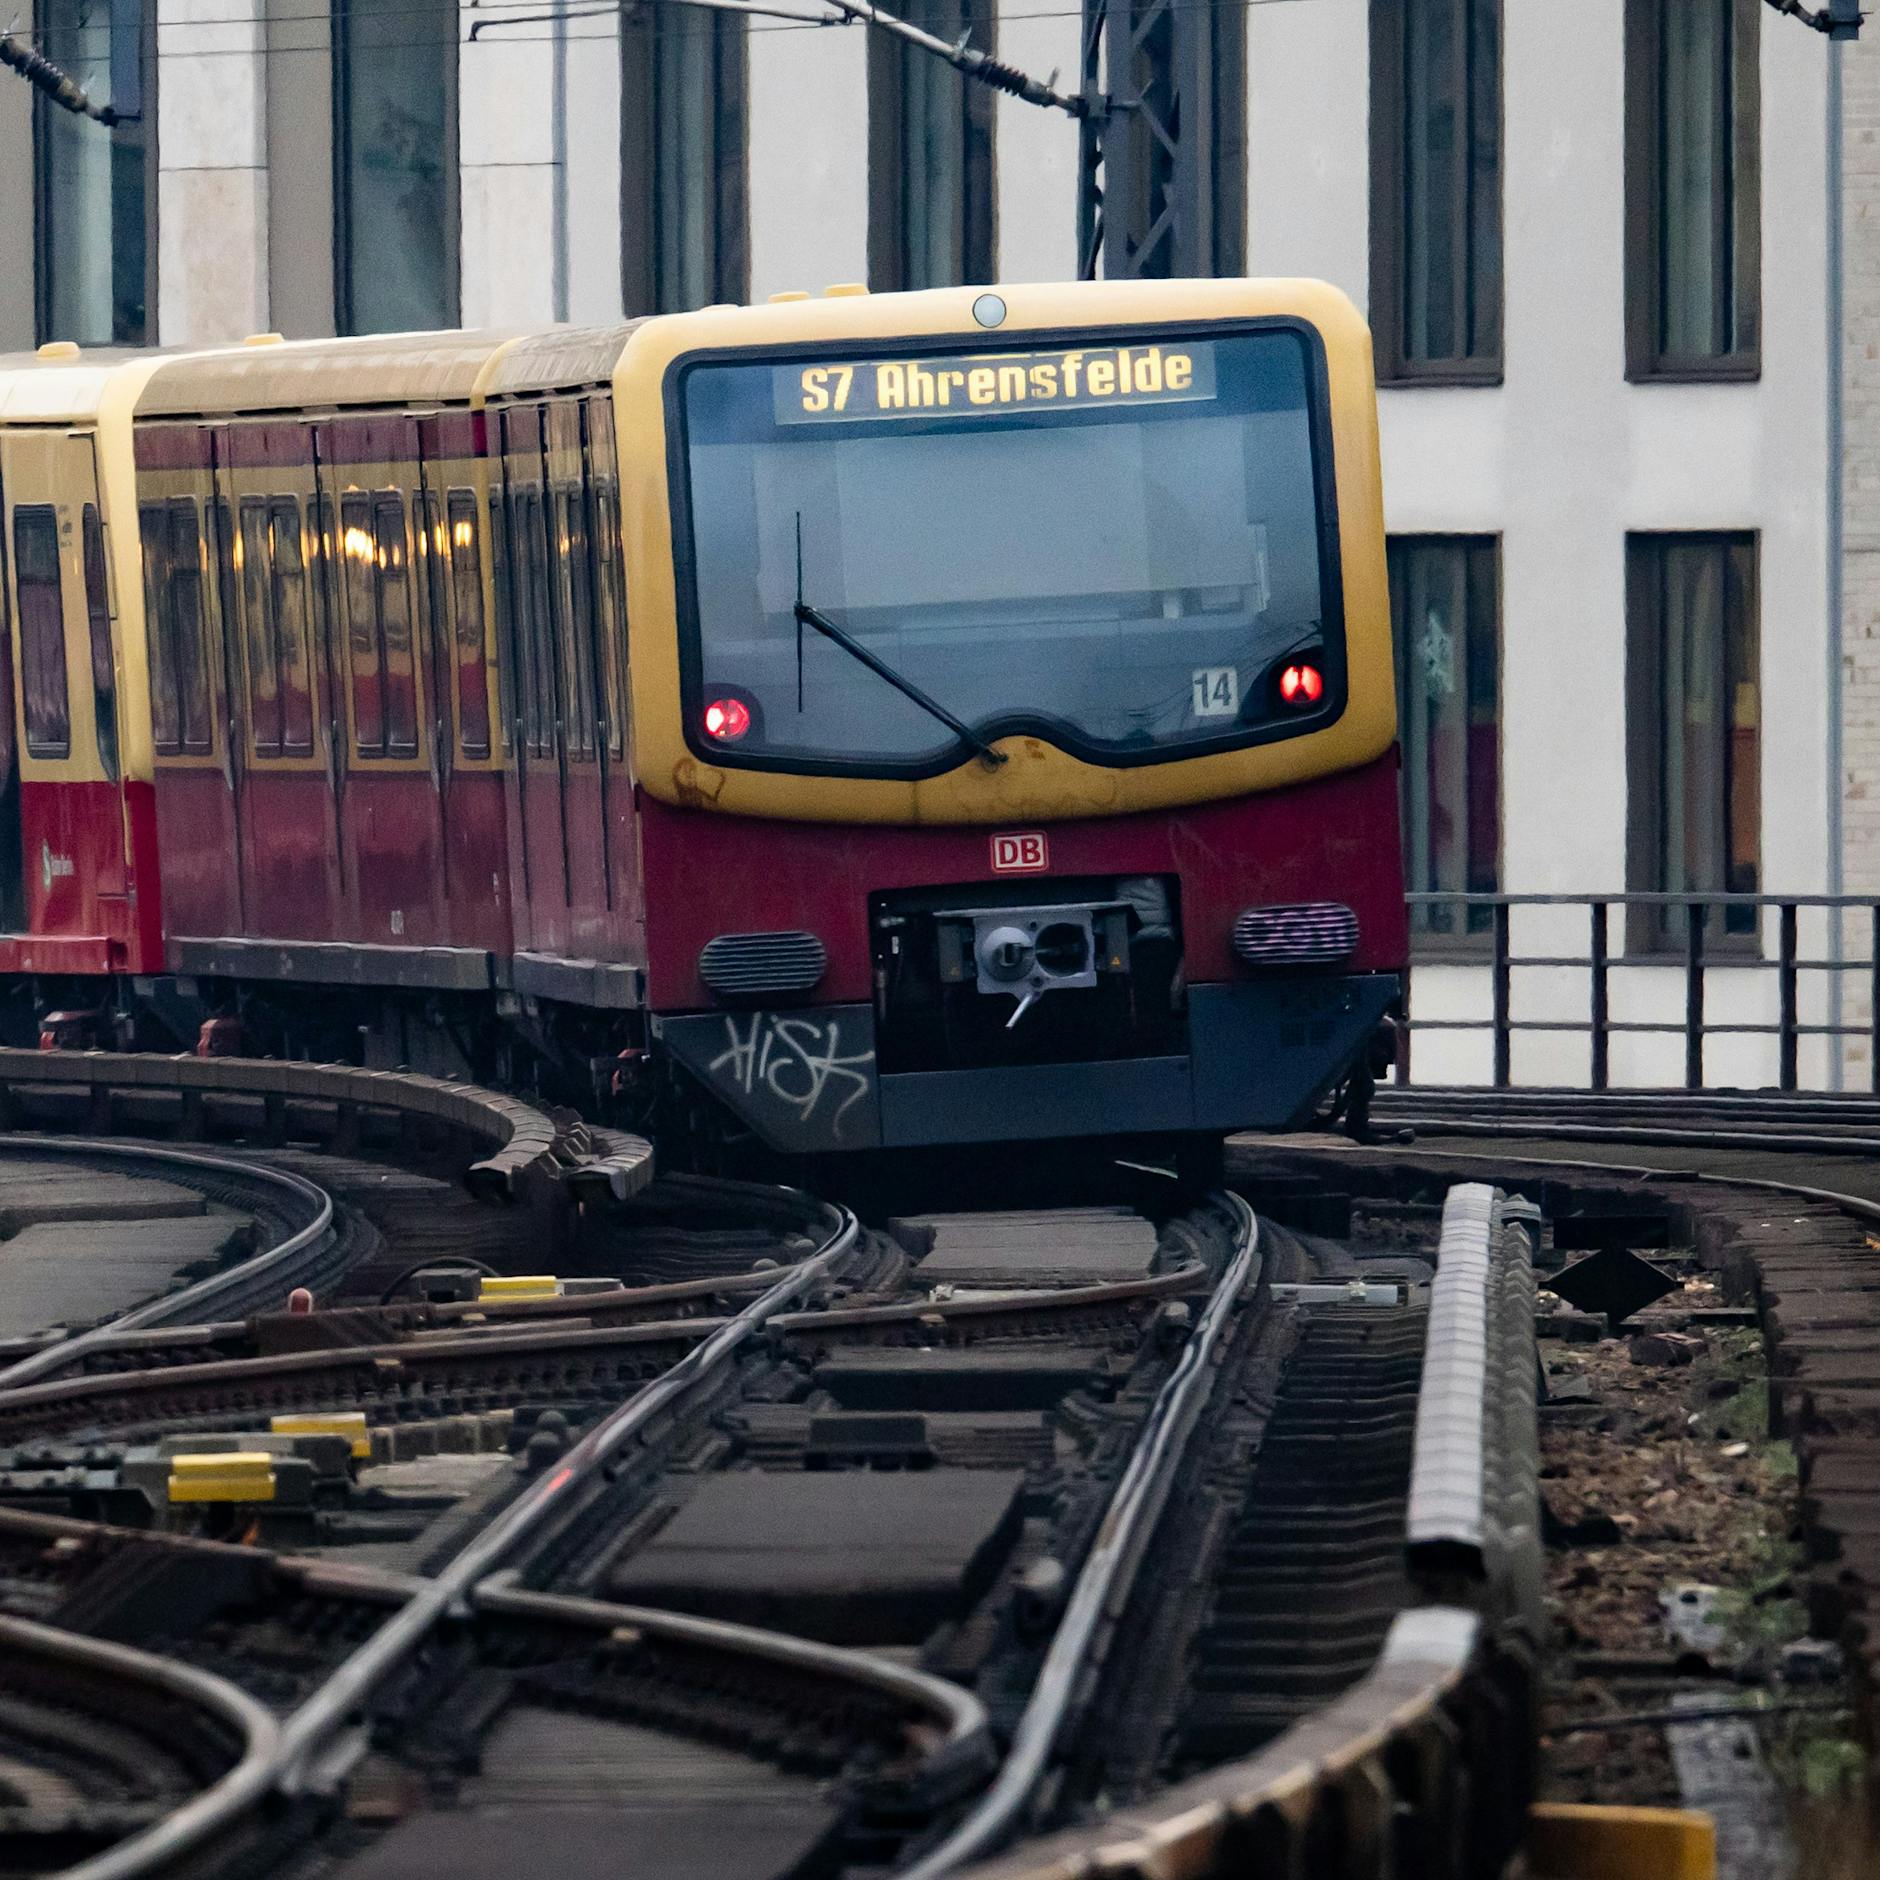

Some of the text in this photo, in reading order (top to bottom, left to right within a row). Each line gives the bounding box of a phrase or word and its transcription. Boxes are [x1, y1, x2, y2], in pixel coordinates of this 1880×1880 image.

[801, 347, 1193, 412] S7 Ahrensfelde
[1194, 671, 1232, 708] 14
[998, 837, 1041, 865] DB
